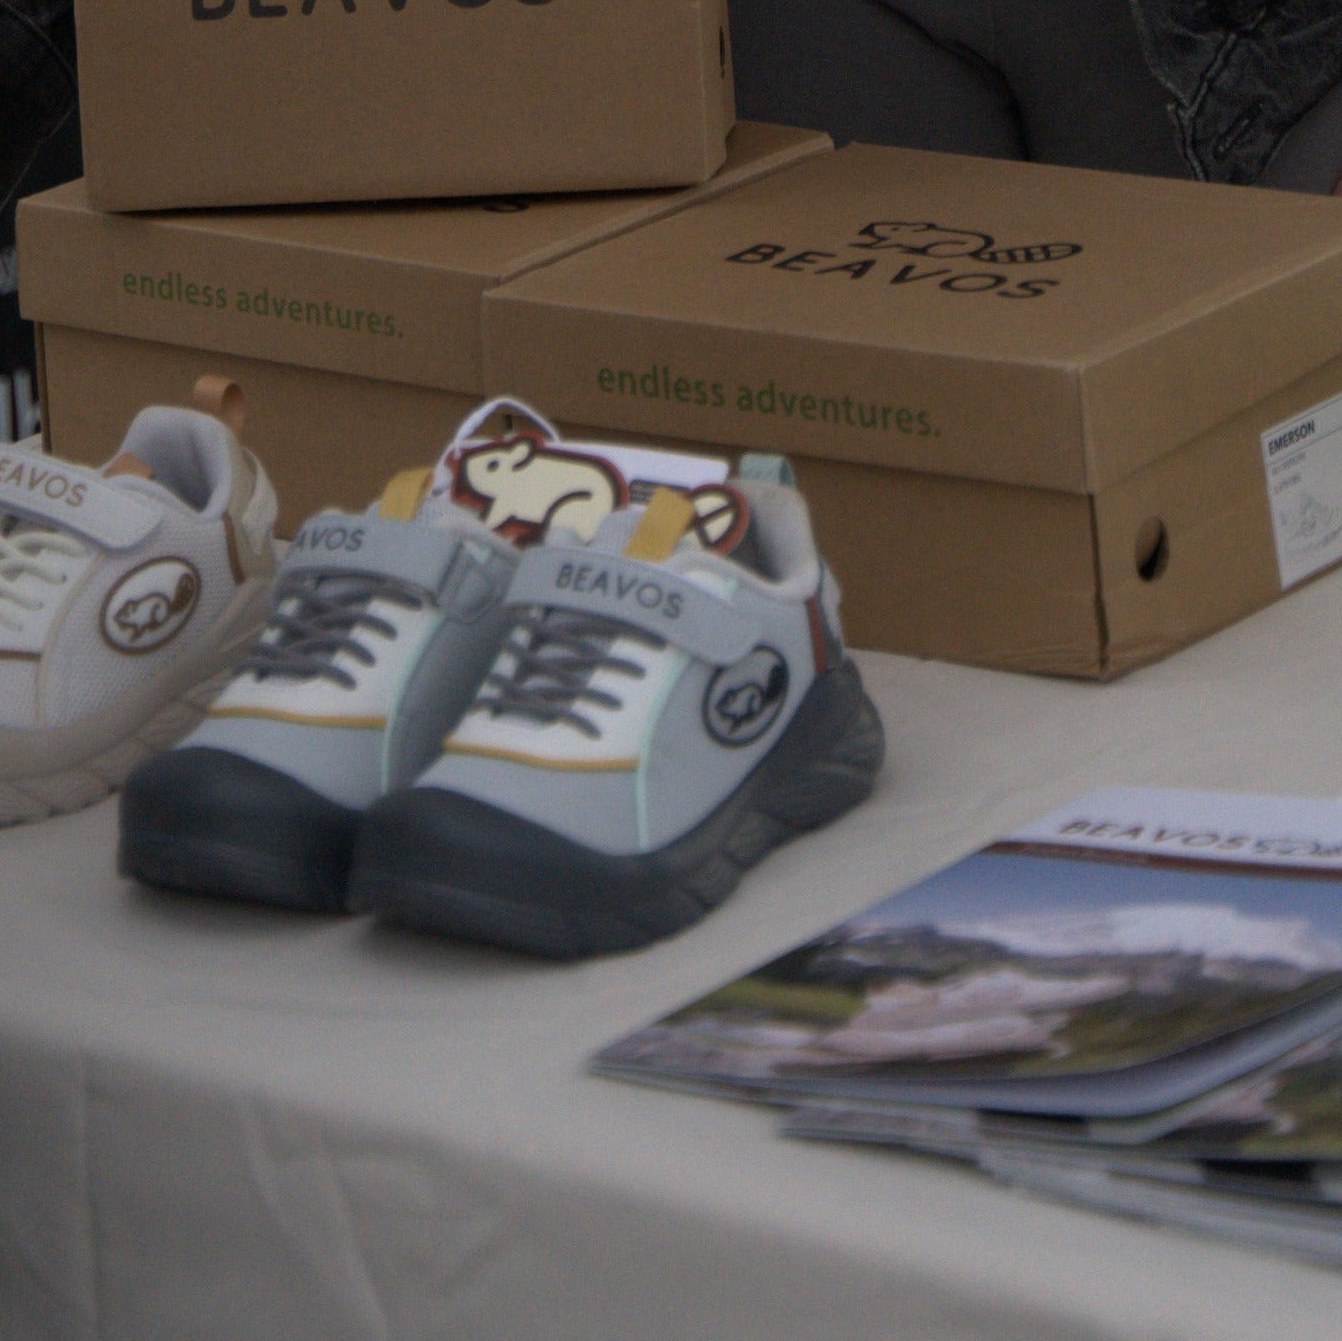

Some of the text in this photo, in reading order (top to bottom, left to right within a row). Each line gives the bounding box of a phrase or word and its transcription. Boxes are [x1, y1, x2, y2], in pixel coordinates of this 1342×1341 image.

[725, 243, 1059, 299] BEAVOS
[122, 271, 405, 341] endless adventures.
[598, 363, 942, 439] endless adventures.
[1268, 419, 1316, 456] EMERSON
[294, 526, 366, 552] AVOS
[555, 563, 684, 619] BEAVOS
[1060, 819, 1247, 853] BEAVOS
